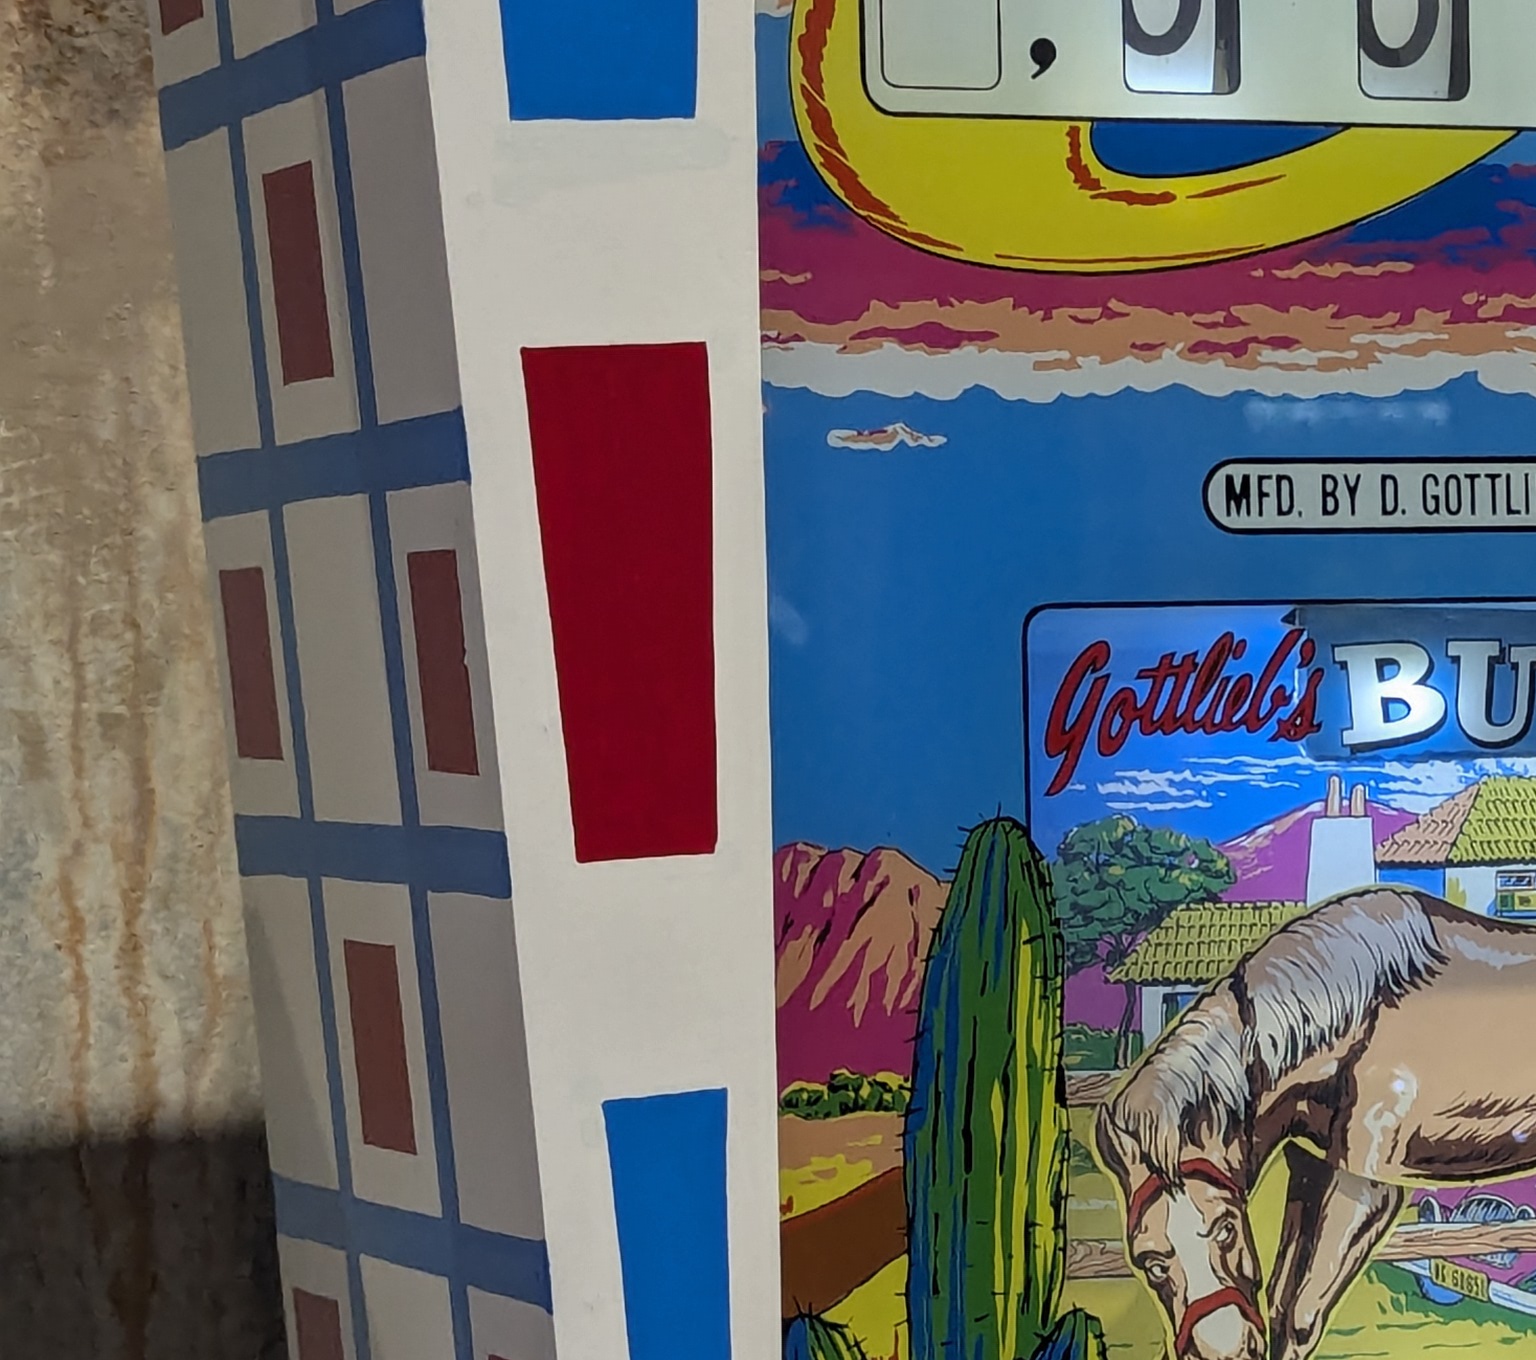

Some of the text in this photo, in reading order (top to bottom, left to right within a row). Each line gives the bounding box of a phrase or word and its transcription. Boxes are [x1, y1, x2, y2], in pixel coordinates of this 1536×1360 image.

[1224, 472, 1303, 518] MFD.
[1321, 472, 1362, 516] BY
[1380, 472, 1407, 515] D.
[1044, 628, 1322, 797] Gottlieb's
